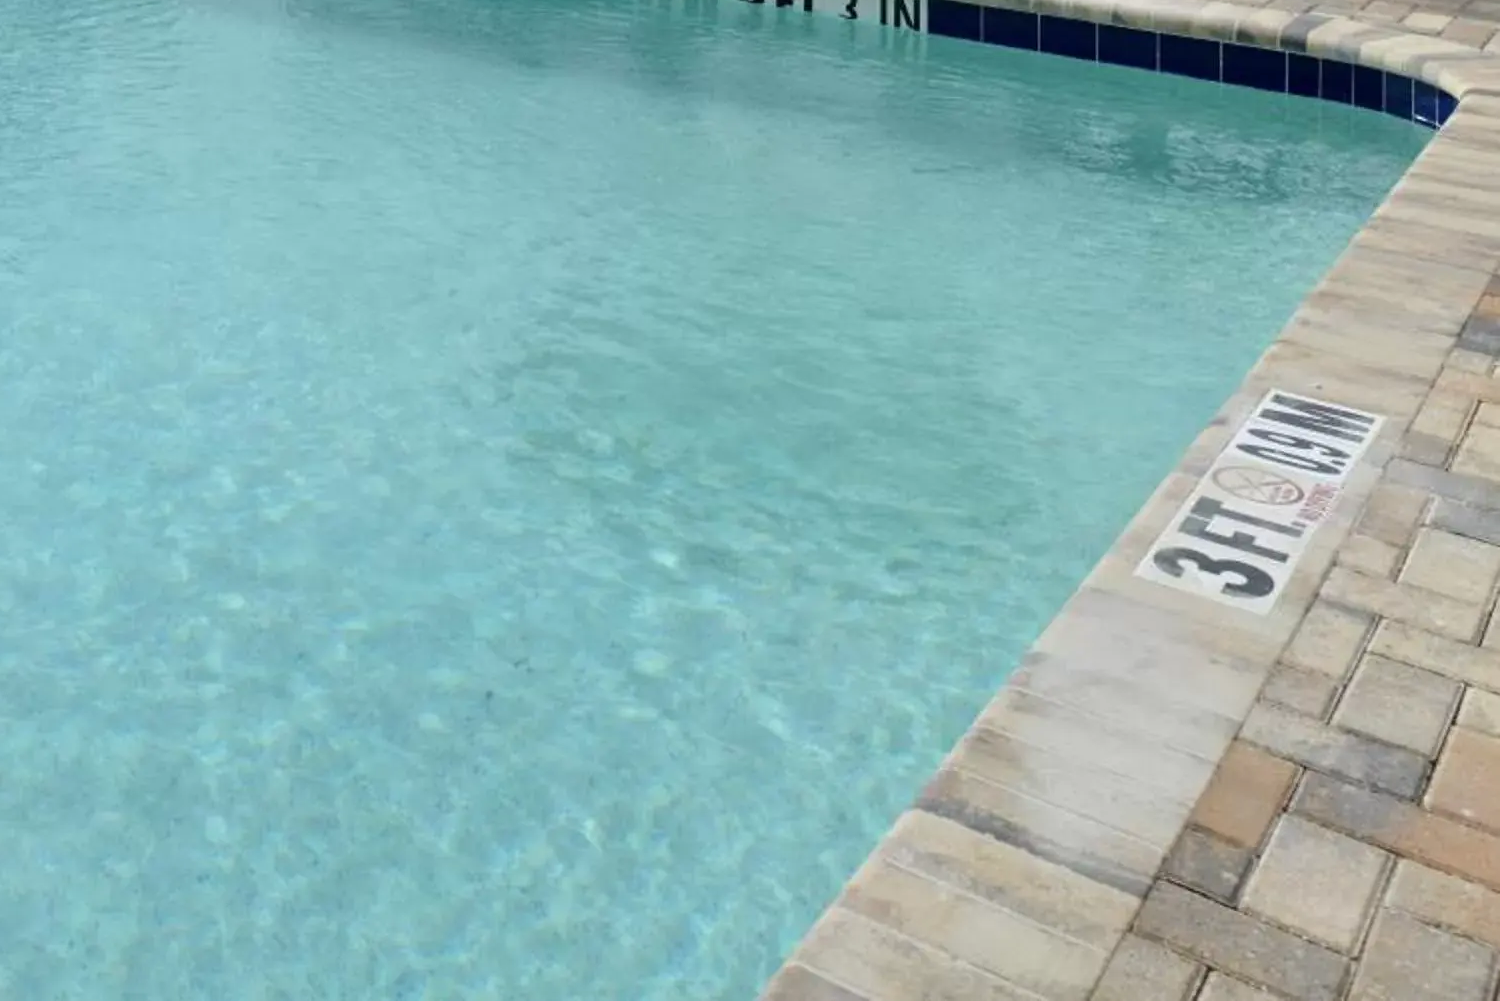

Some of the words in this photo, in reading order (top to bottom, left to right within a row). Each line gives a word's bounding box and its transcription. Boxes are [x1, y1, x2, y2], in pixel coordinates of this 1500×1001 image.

[1258, 394, 1376, 444] M
[1236, 428, 1351, 475] 0.9
[1153, 547, 1275, 598] 3
